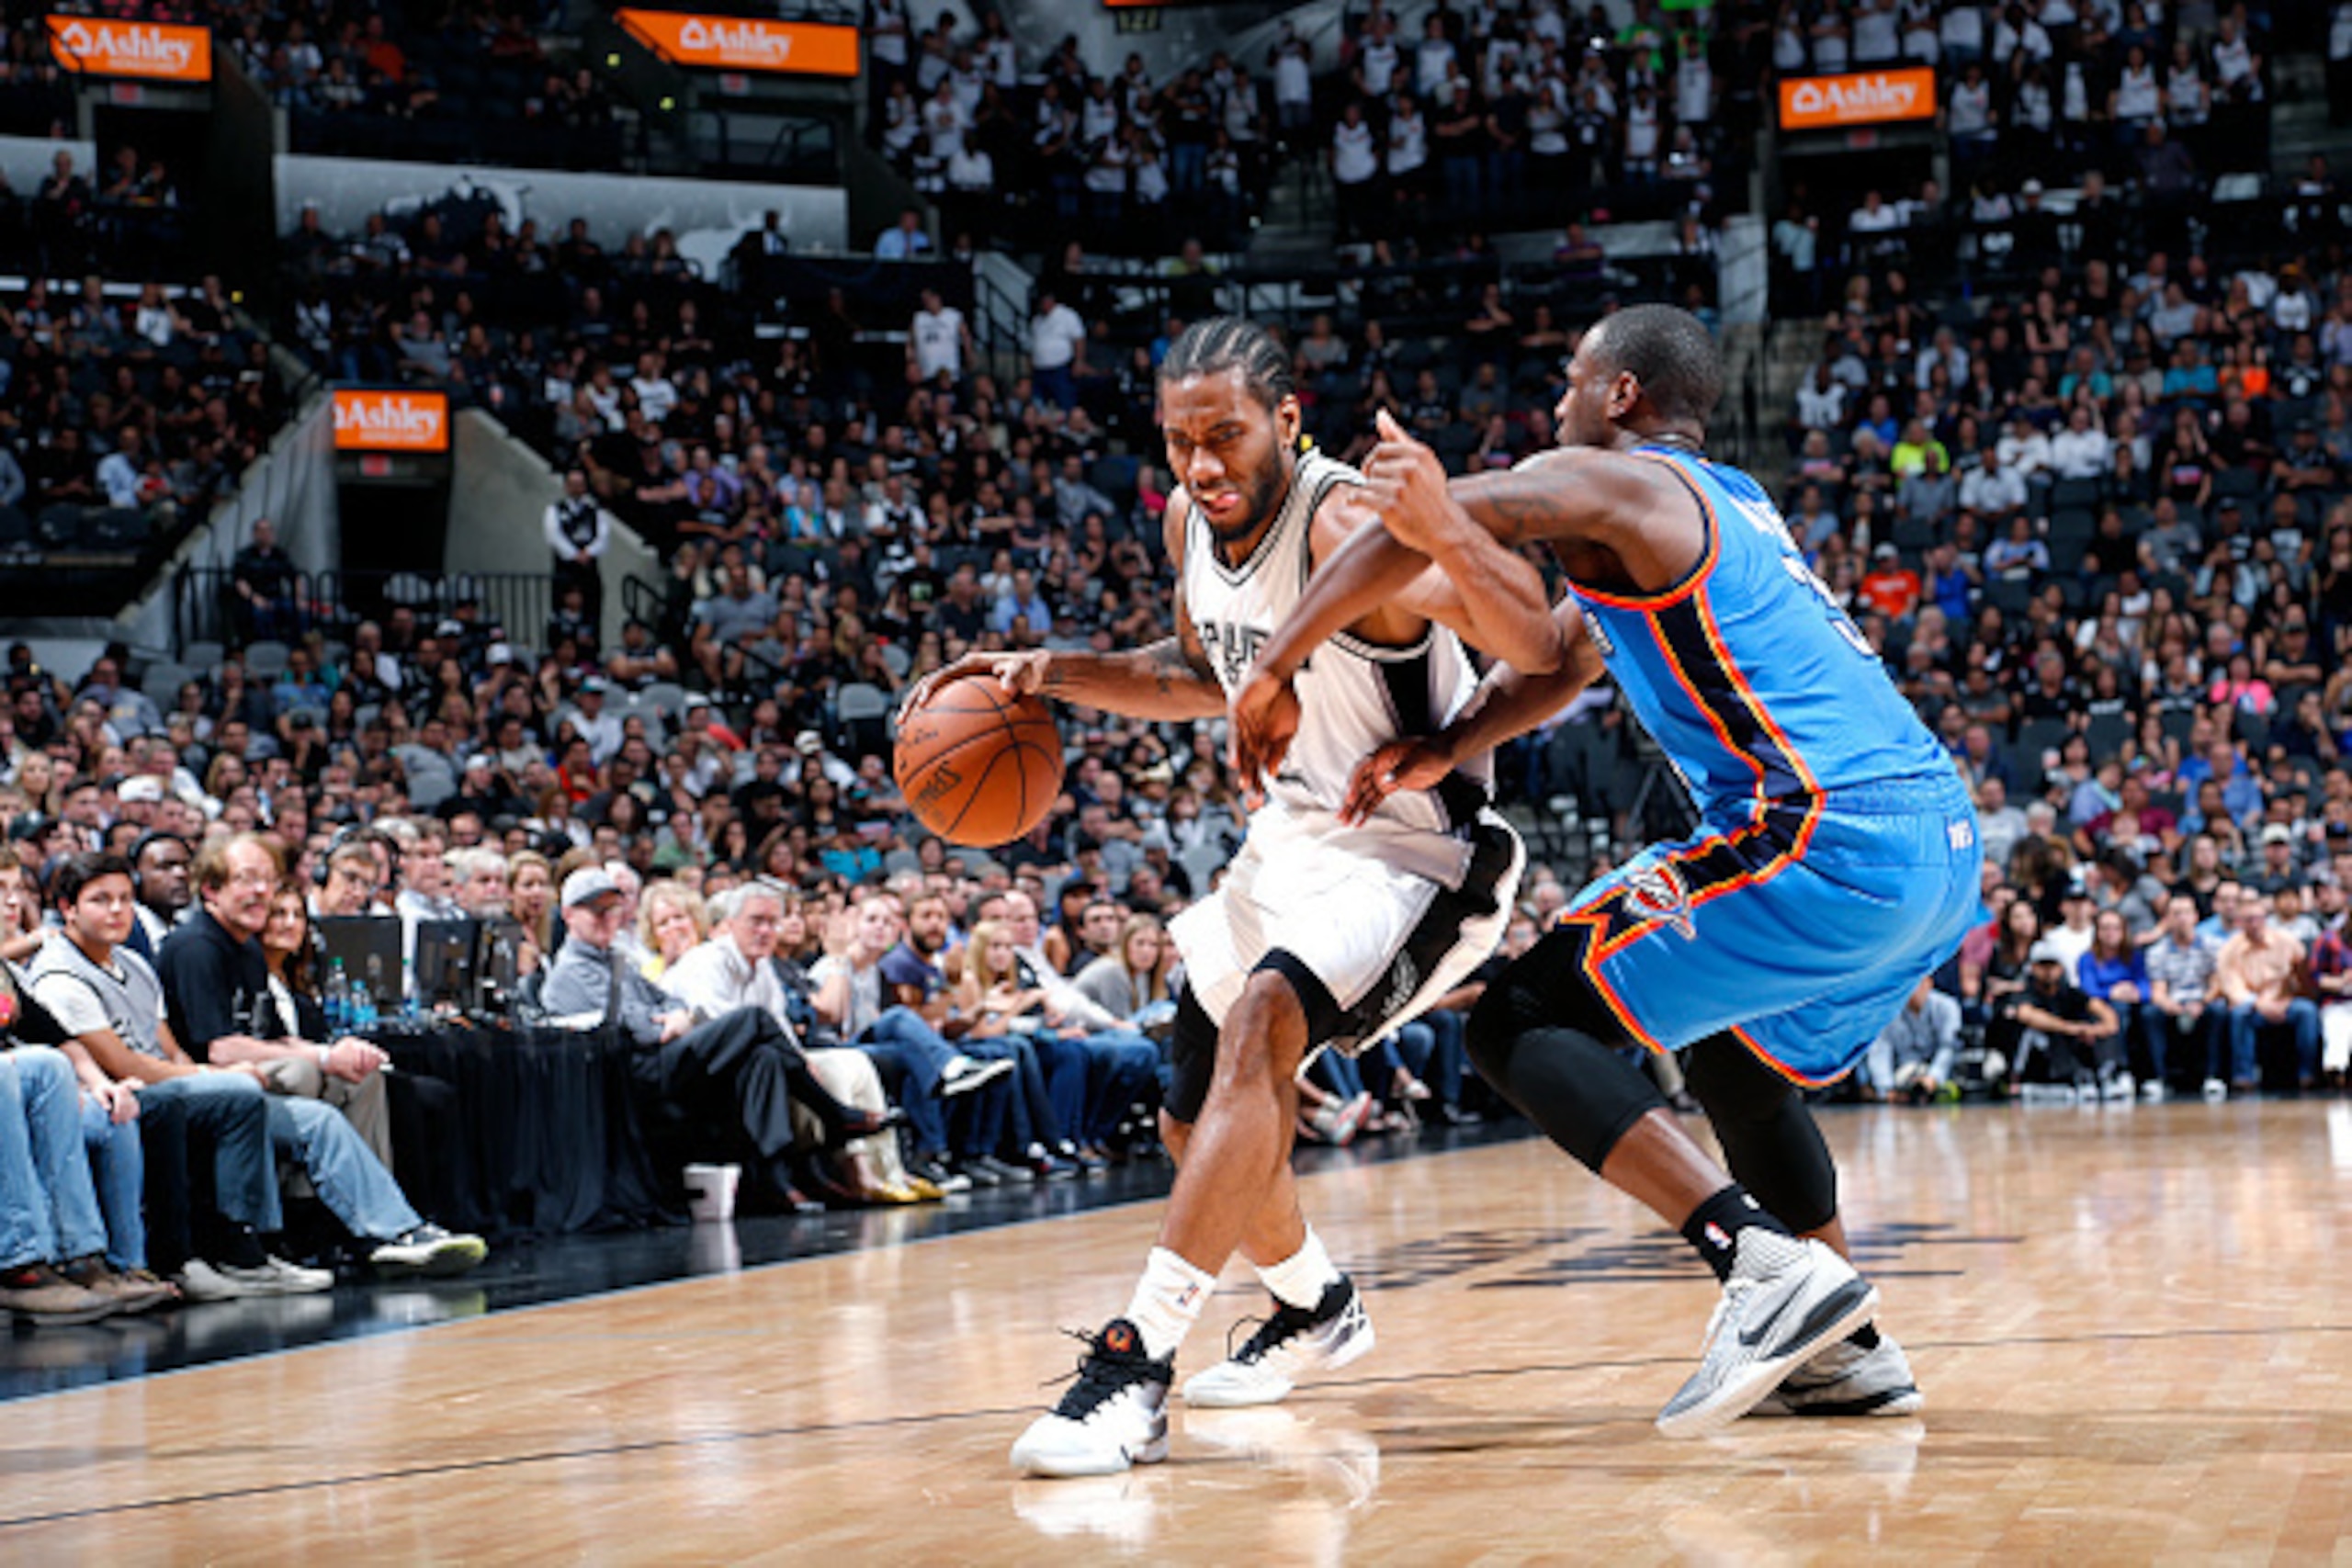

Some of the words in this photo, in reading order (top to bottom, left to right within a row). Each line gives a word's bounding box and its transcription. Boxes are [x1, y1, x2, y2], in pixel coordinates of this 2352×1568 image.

[93, 25, 195, 70] Ashley
[1824, 74, 1917, 111] Ashley
[347, 395, 442, 438] Ashley
